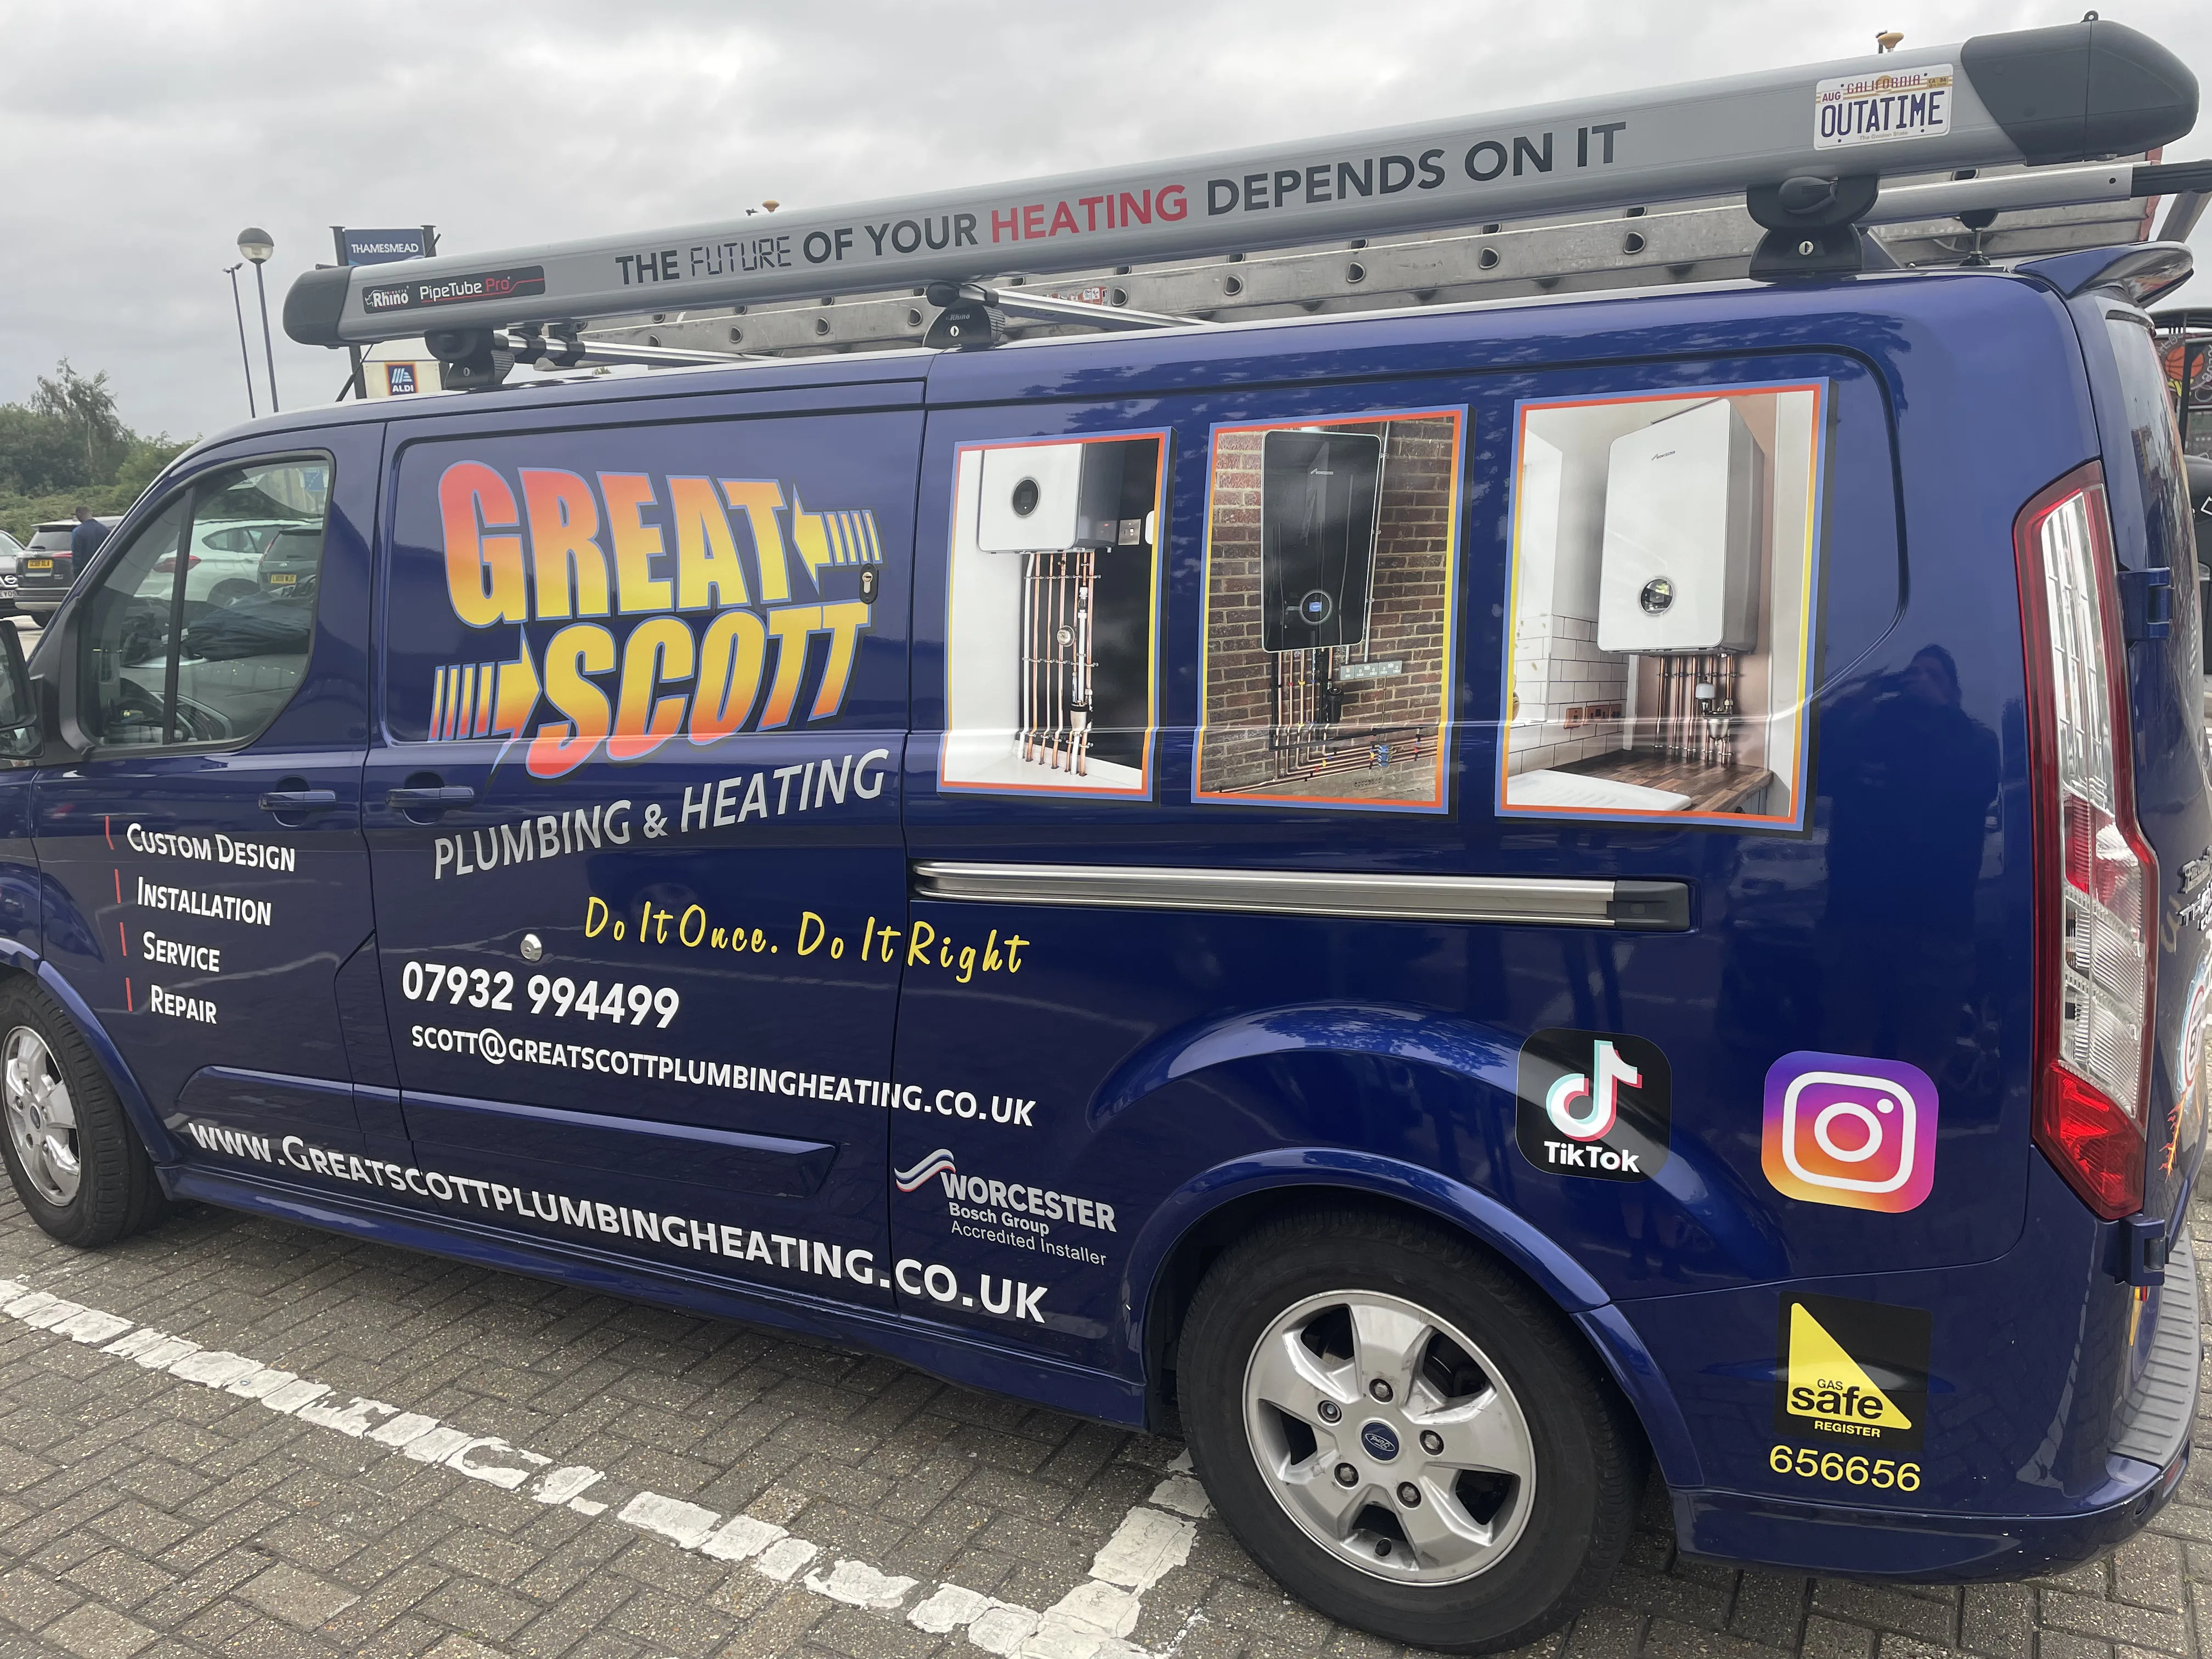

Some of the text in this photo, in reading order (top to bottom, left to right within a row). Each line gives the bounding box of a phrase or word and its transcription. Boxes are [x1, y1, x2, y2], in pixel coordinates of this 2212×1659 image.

[1822, 92, 1841, 102] AUG
[1847, 75, 1921, 94] CALIFORNIA
[1821, 91, 1945, 138] OUTATIME
[616, 121, 1626, 285] THE FUTURE OF YOUR HEATING DEPENDS ON IT
[351, 244, 419, 253] THAMESMEAD
[373, 278, 510, 307] Rhino PipeTube Pro
[392, 384, 414, 392] ALDI
[438, 460, 792, 629] GREAT
[526, 600, 871, 780] SCOTT
[434, 748, 889, 880] PLUMBING & HEATING
[127, 823, 295, 872] CUSTOM DESIGN
[137, 876, 272, 926] INSTALLATION
[143, 931, 220, 972] SERVICE
[585, 896, 1030, 983] Do It Once. Do It Right
[151, 984, 217, 1024] REPAIR
[402, 961, 680, 1028] 07932 994499
[411, 1025, 1036, 1127] SCOTT@GREATSCOTTPLUMBINGHEATING.CO.UK
[1544, 1141, 1640, 1173] TikTok
[188, 1122, 1048, 1323] WWW.GREATSCOTTPLUMBINGHEATING.CO.UK
[940, 1171, 1118, 1233] WORCESTER
[949, 1201, 1049, 1237] Bosch Group
[951, 1220, 1107, 1266] Accredited Installer
[1791, 1386, 1883, 1419] safe
[1817, 1379, 1843, 1390] GAS
[1370, 1436, 1390, 1449] Ford
[1814, 1420, 1881, 1437] REGISTER
[1769, 1445, 1921, 1492] 656656
